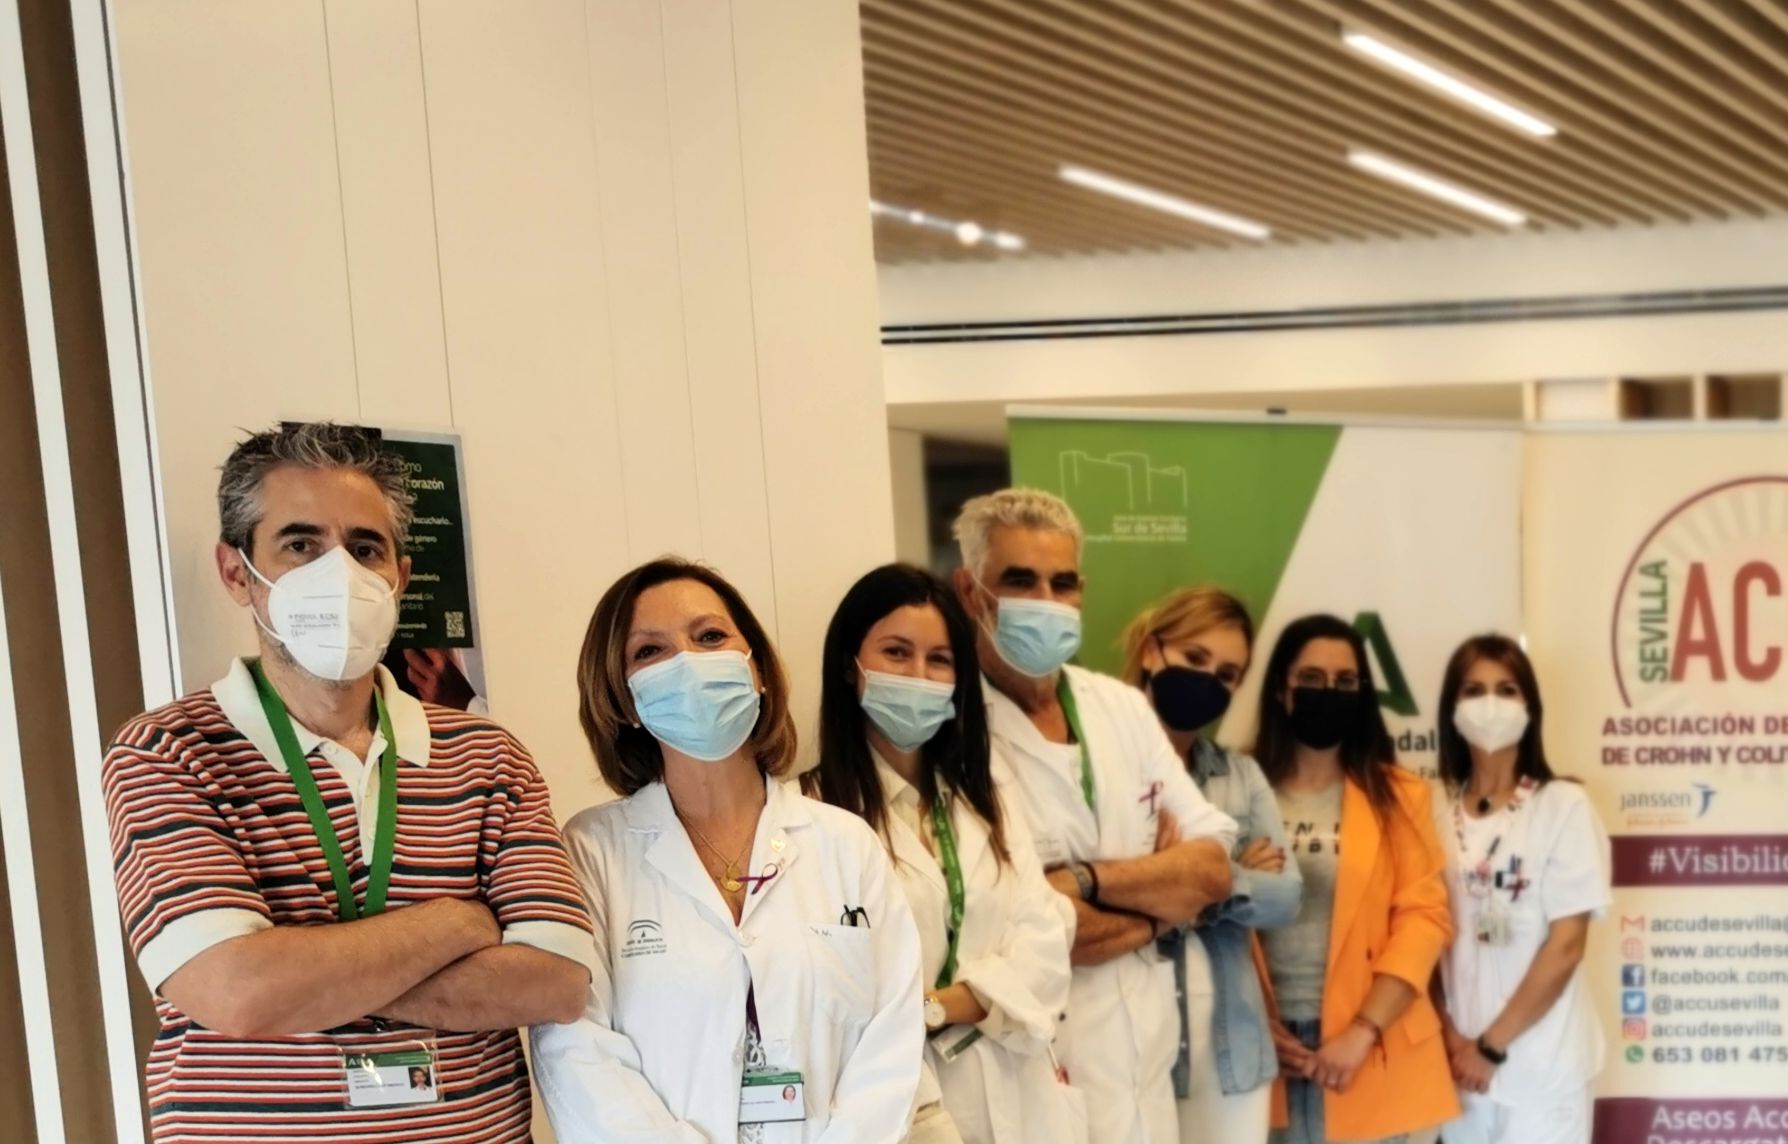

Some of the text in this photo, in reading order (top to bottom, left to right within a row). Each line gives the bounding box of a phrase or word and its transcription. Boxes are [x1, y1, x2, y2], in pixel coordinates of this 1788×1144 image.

[1638, 559, 1668, 684] SEVILLA
[1602, 713, 1755, 736] ASOCIACIÓN
[1601, 746, 1630, 765] DE
[1634, 746, 1711, 765] CROHN
[1716, 746, 1732, 764] Y
[1619, 790, 1692, 813] janssen
[1652, 994, 1780, 1015] @accusevilla
[1652, 1020, 1783, 1038] accudesevilla
[1652, 1046, 1788, 1063] 653 081 475
[1652, 1104, 1735, 1130] Aseos
